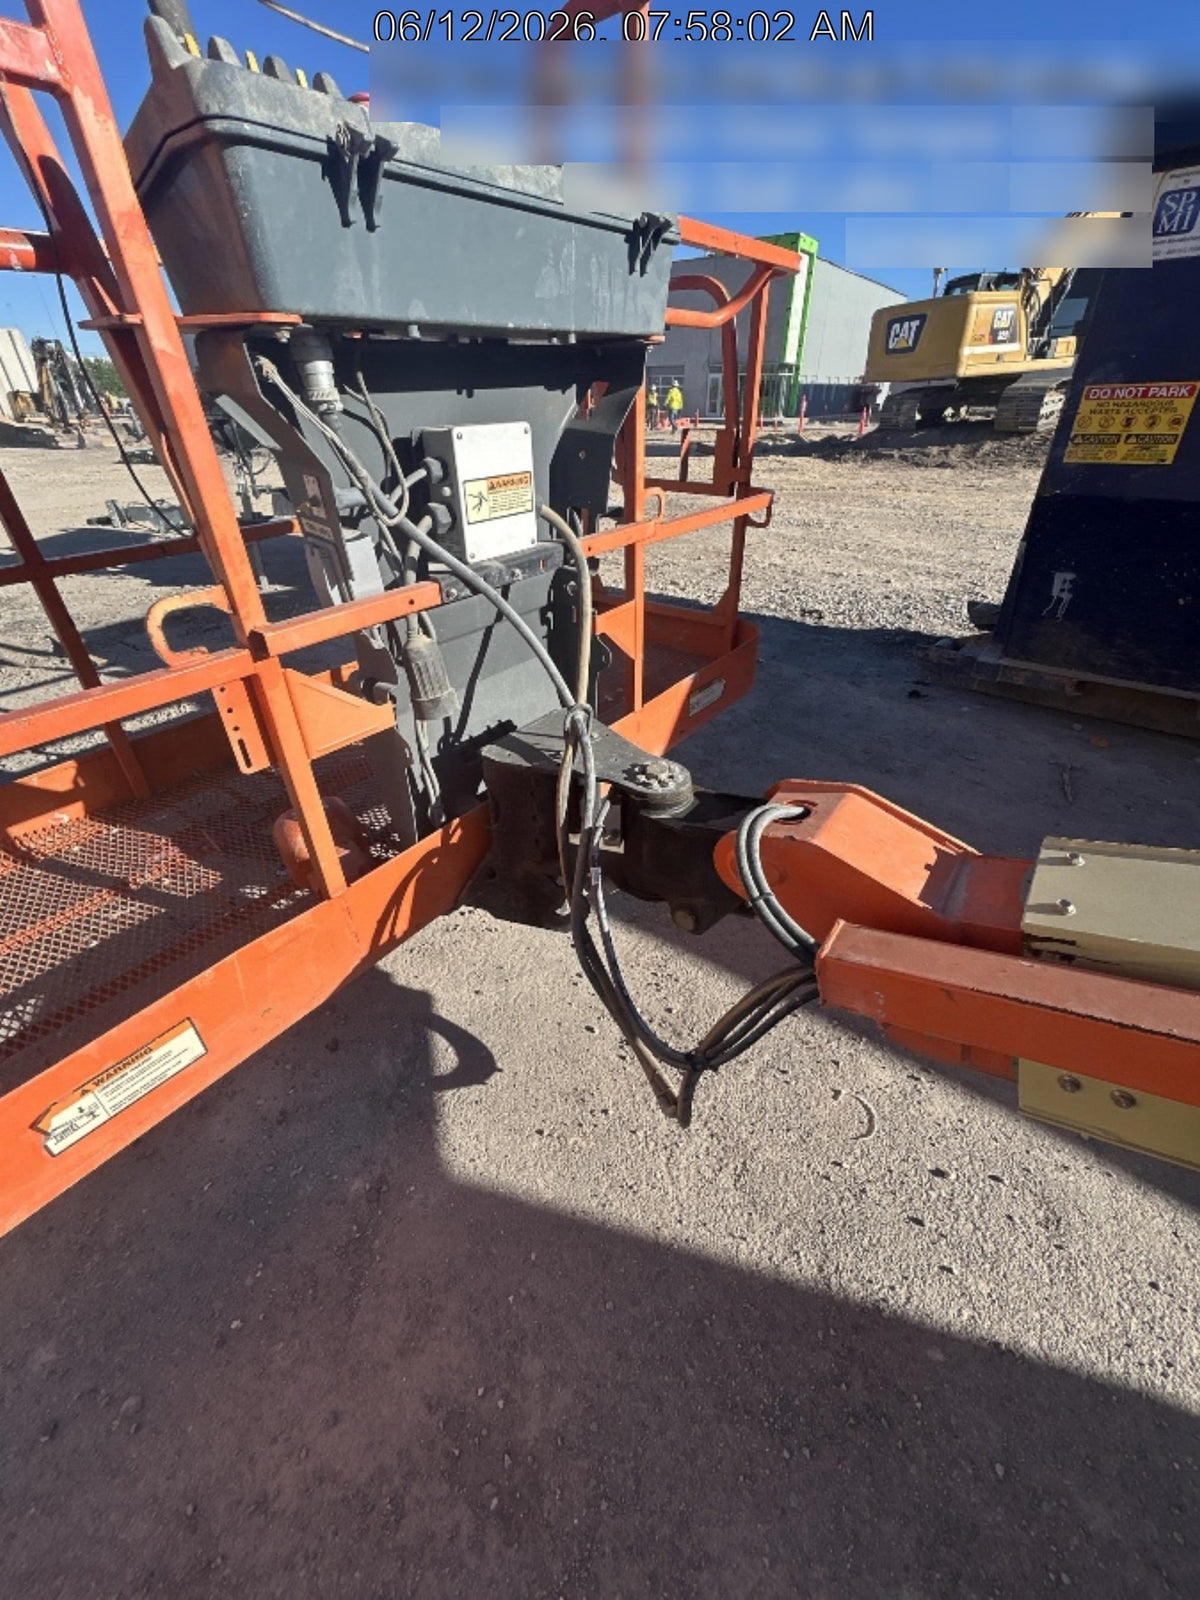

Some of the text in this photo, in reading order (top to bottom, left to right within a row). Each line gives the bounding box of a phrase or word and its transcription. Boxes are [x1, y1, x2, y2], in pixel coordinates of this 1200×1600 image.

[888, 319, 919, 350] CAT
[1089, 385, 1192, 399] DO NOT PARK
[92, 1045, 153, 1087] WARNING
